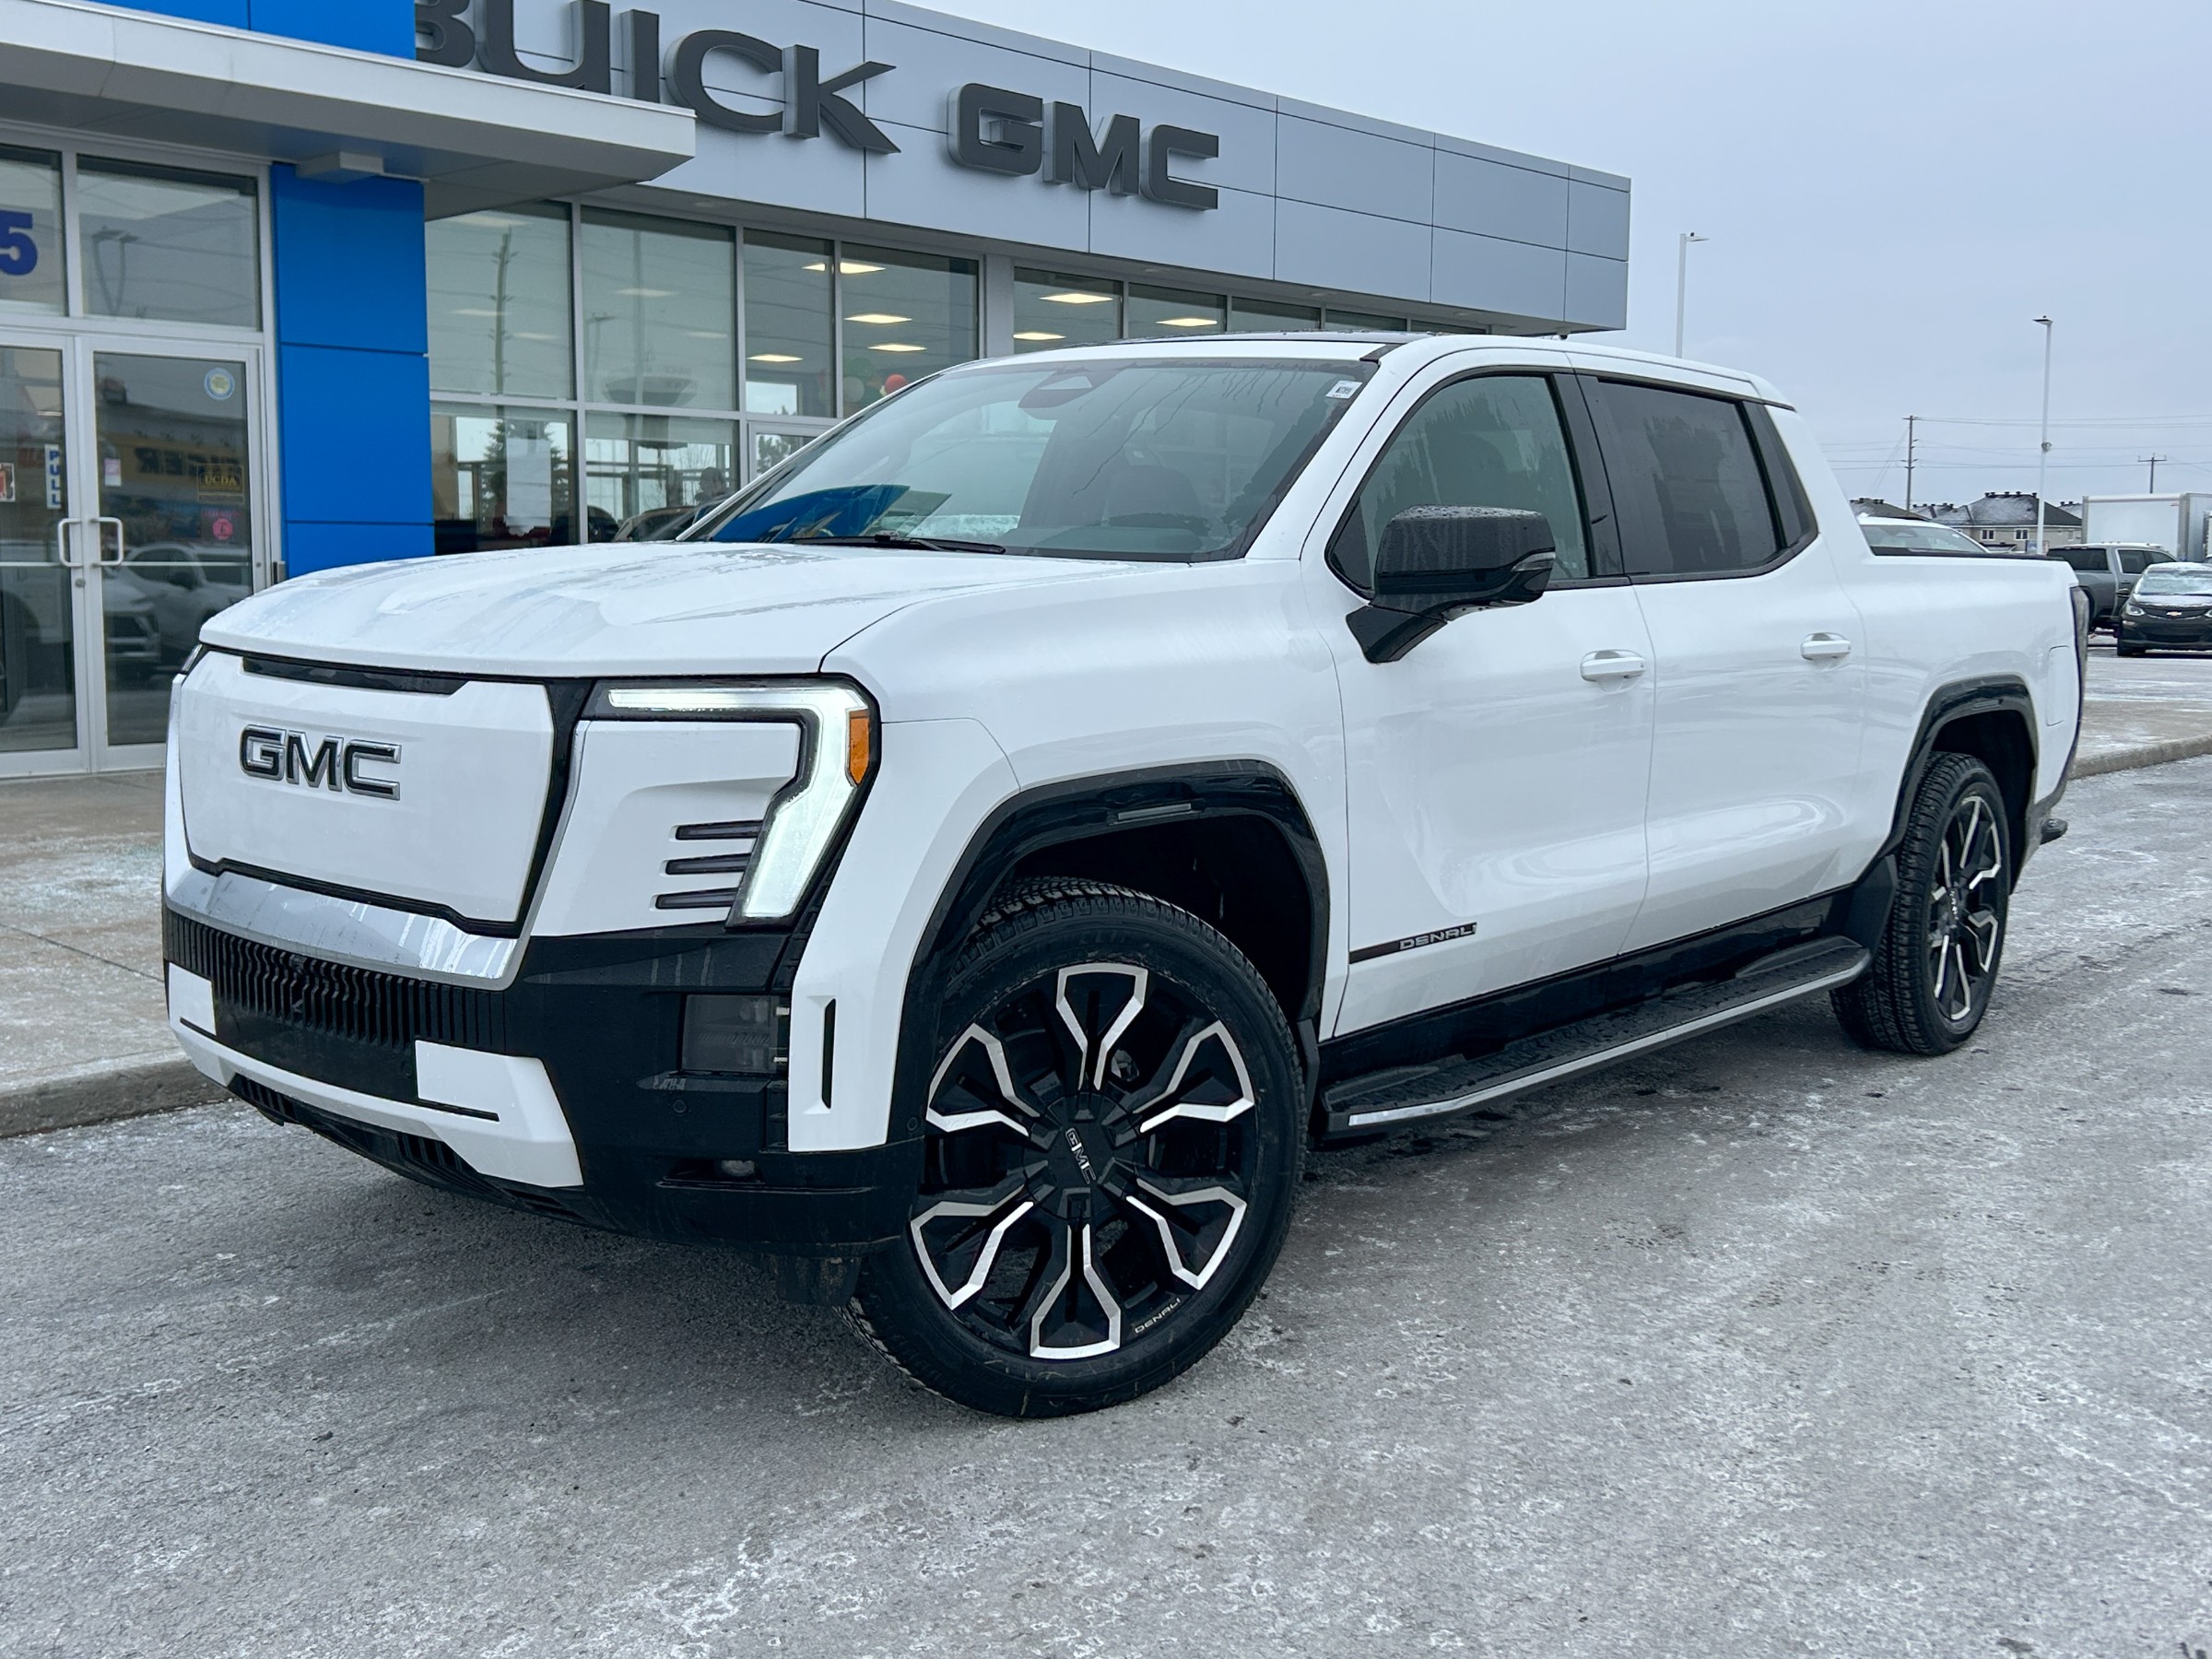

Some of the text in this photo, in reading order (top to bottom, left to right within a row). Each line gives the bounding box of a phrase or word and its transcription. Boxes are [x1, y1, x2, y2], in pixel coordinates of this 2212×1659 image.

[948, 83, 1218, 212] GMC
[49, 449, 61, 506] PULL
[205, 474, 237, 487] UCDA
[240, 724, 402, 801] GMC
[1399, 924, 1477, 950] DENALI
[1065, 1127, 1097, 1184] GMC
[1135, 1297, 1181, 1334] DENALI
